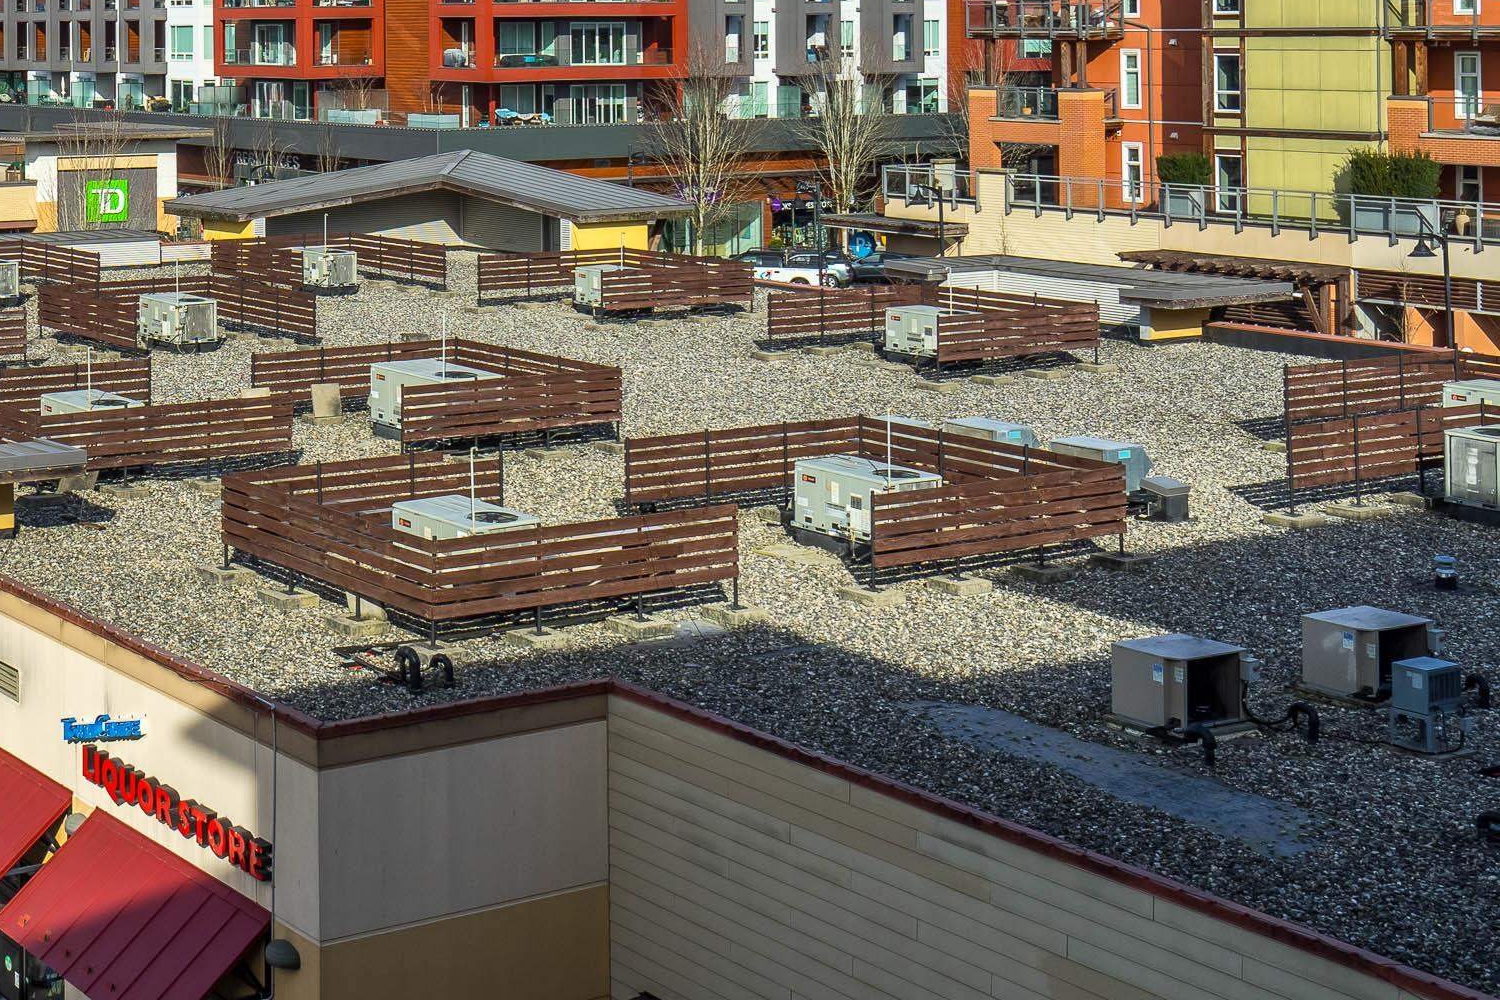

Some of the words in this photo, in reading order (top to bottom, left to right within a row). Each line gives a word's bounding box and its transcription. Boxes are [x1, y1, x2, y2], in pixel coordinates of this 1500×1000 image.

[92, 189, 125, 214] TD
[82, 744, 179, 830] LIQUOR
[178, 799, 272, 882] STORE
